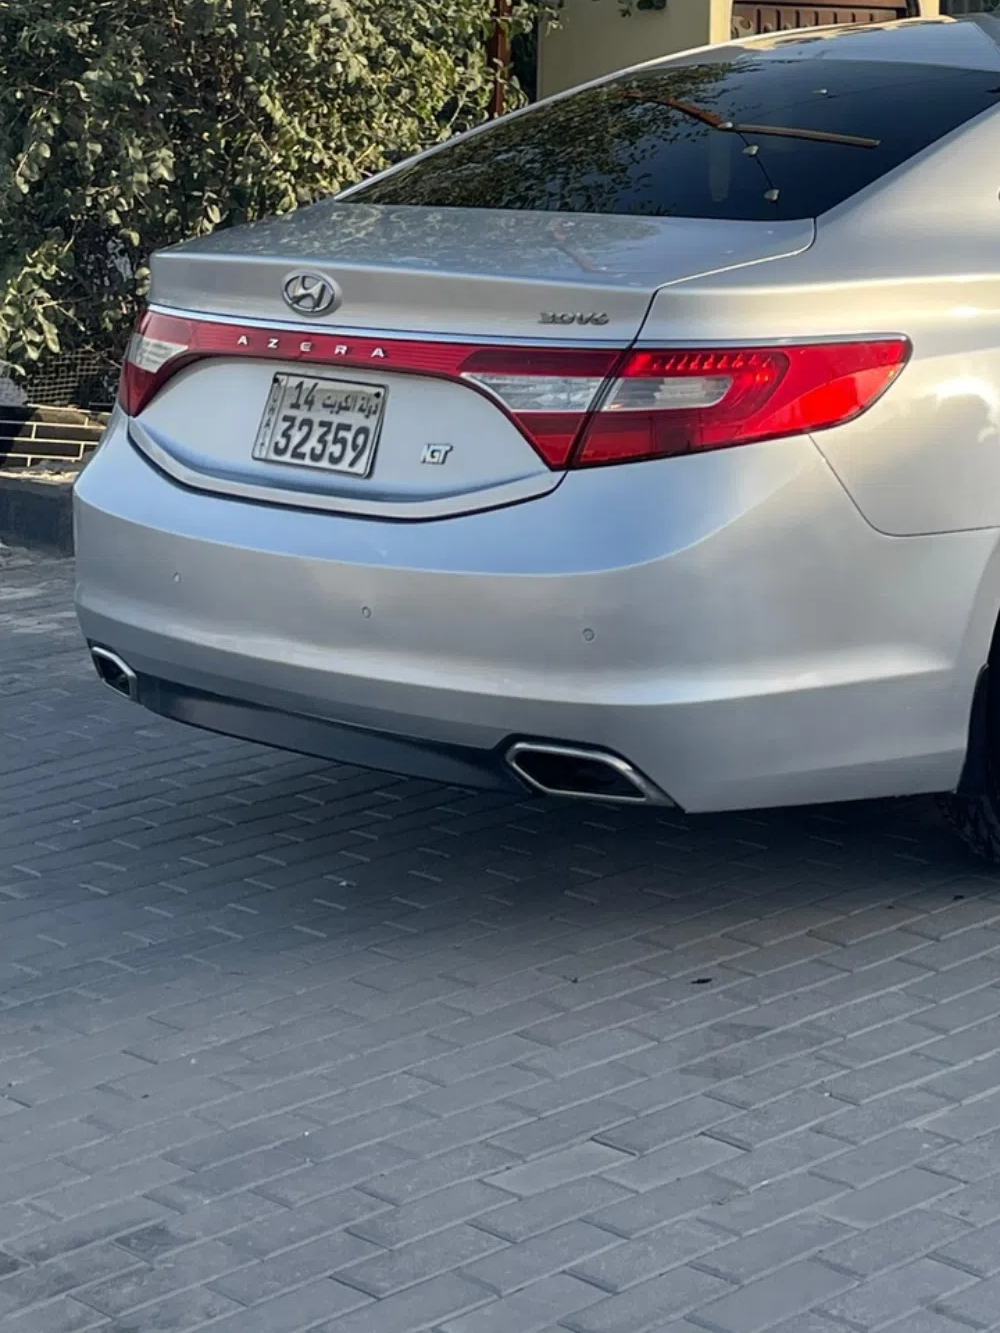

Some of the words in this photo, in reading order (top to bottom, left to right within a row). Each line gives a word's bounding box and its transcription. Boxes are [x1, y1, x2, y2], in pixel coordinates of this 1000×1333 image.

[236, 335, 386, 358] AZERA
[289, 380, 319, 411] 14
[321, 394, 359, 415] الكويت
[273, 414, 371, 468] 32359
